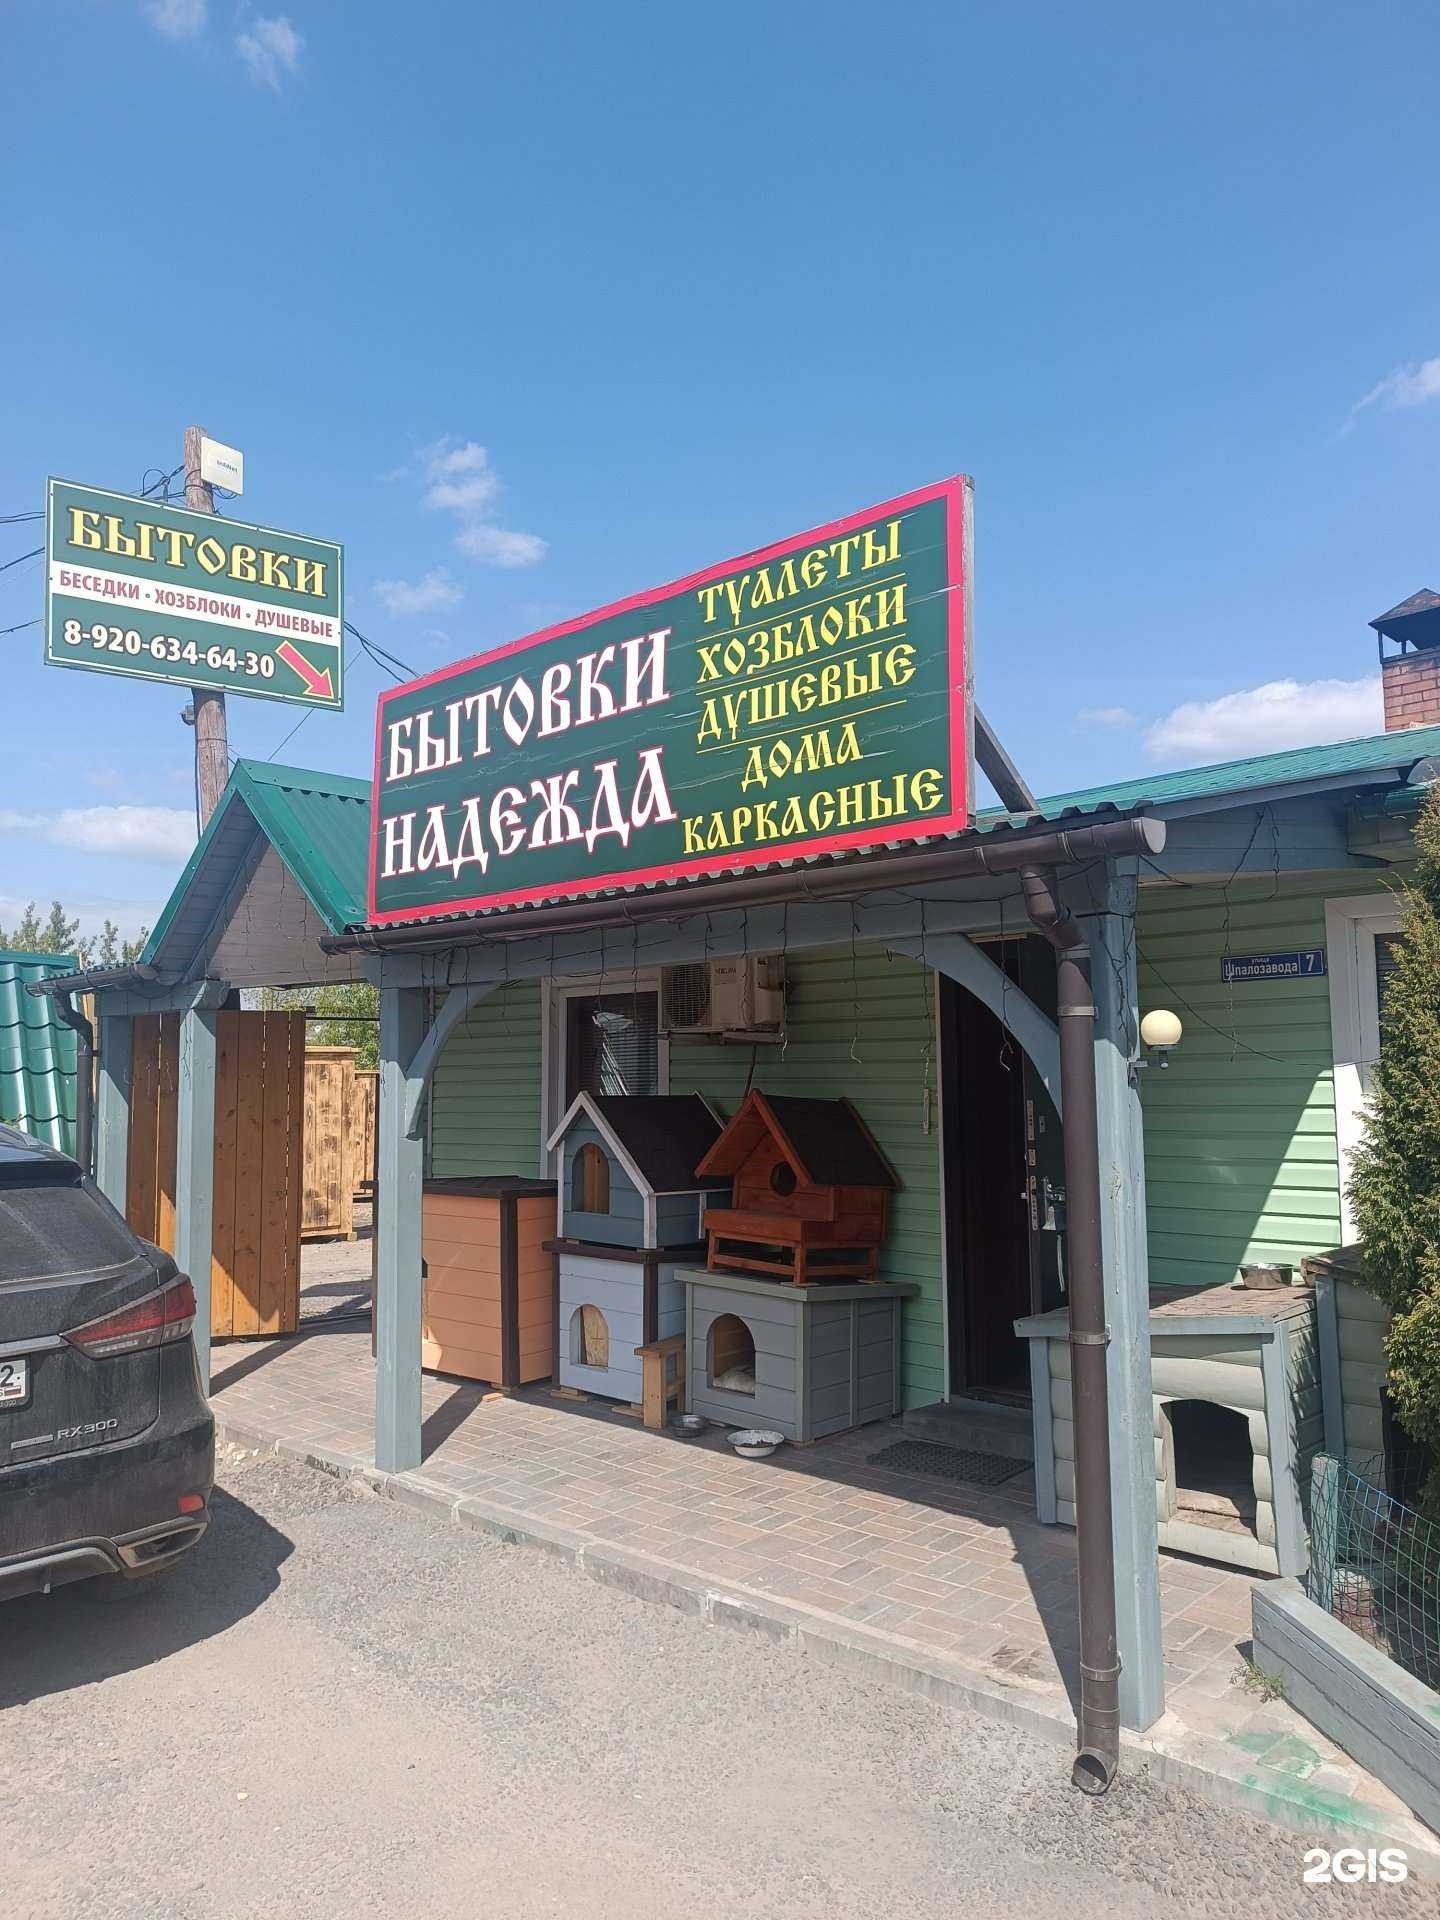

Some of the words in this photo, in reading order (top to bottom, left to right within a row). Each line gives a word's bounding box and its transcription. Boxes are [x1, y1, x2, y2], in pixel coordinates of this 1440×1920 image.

[67, 507, 327, 597] БЫТОВКИ
[697, 520, 902, 626] ТУАЛЕТЫ
[60, 570, 140, 600] БЕСЕДКИ
[155, 589, 242, 619] ХОЗБЛОКИ
[255, 609, 333, 638] ДУШЕВЫЕ
[63, 619, 276, 679] 8-920-634-64-30
[696, 584, 908, 683] ХОЗБЛОКИ
[385, 627, 672, 783] БЫТОВКИ
[697, 643, 917, 743] ДУШЕВЫЕ
[741, 723, 864, 792] ДОМА
[381, 747, 677, 879] НАДЕЖДА
[683, 768, 944, 854] КАРКАСНЫЕ
[1225, 962, 1297, 977] Шпалозавода
[1305, 954, 1314, 972] 7
